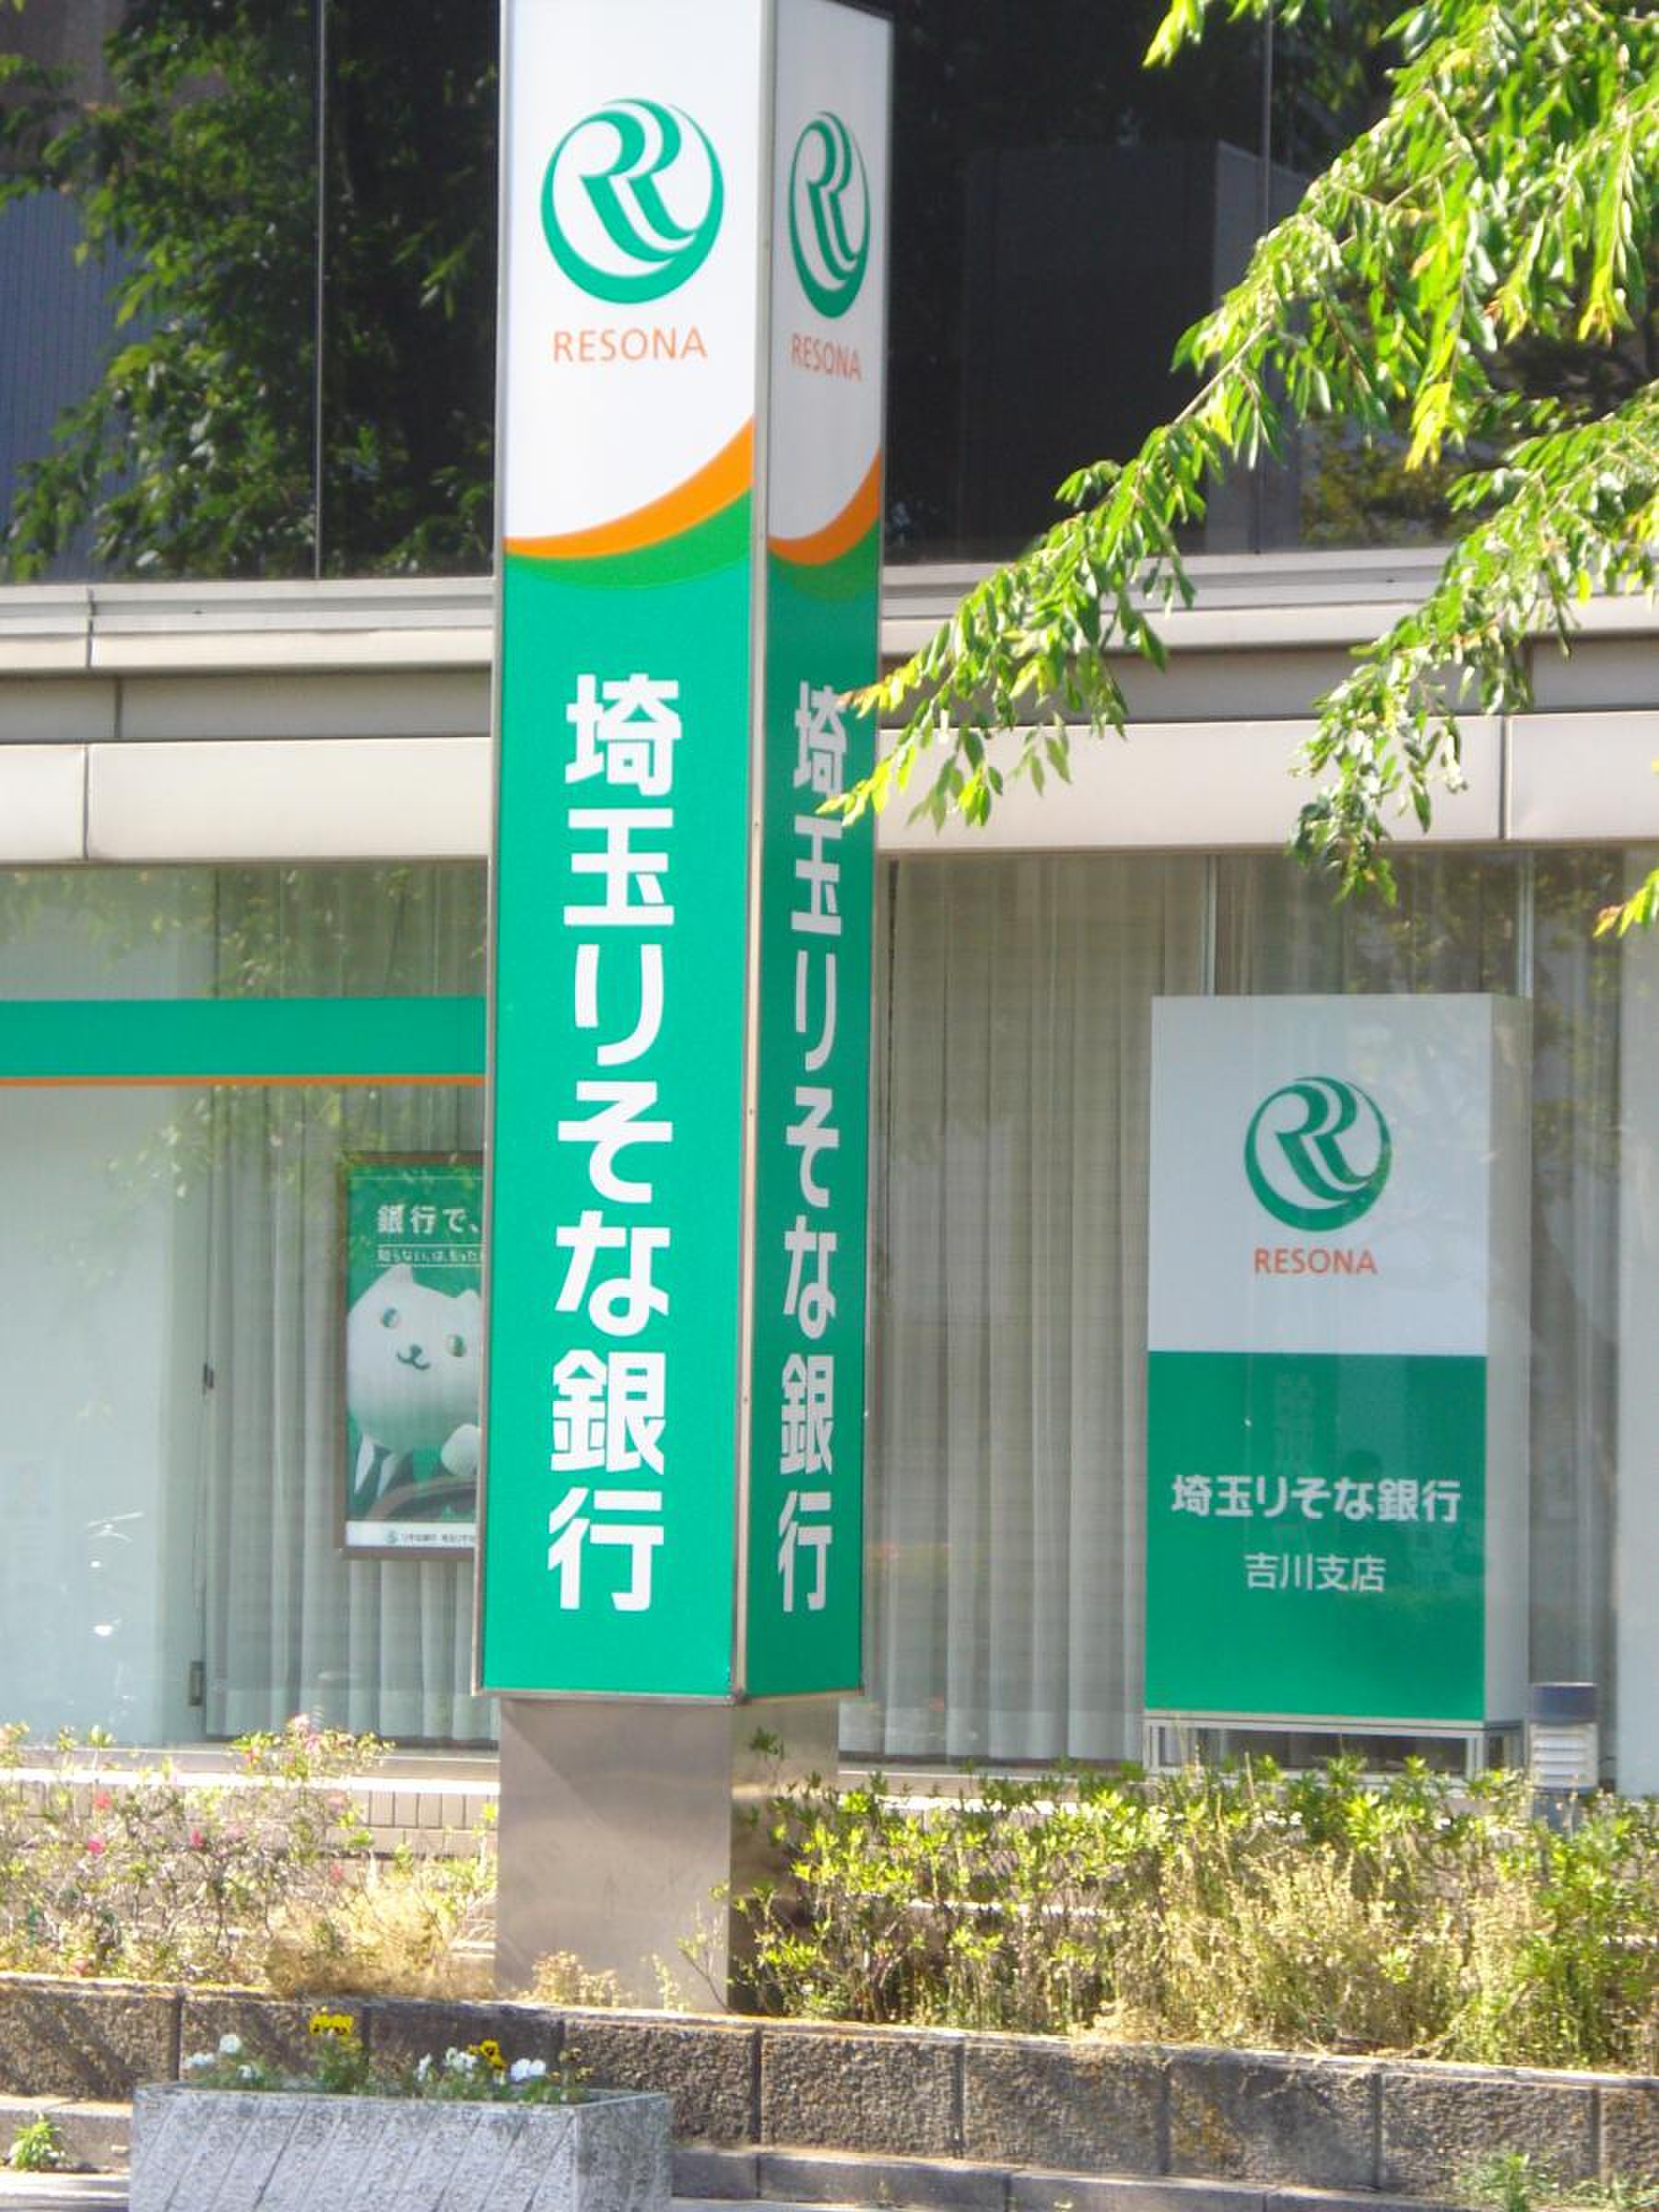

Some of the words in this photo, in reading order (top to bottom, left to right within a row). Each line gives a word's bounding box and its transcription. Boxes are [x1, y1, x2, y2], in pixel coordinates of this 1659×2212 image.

[553, 325, 708, 362] RESONA
[791, 333, 862, 380] RESONA
[547, 673, 682, 1611] 埼玉りそな銀行
[778, 680, 847, 1612] 埼玉りそな銀行
[1254, 1248, 1377, 1275] RESONA
[1171, 1474, 1462, 1523] 埼玉りそな銀行
[1244, 1552, 1387, 1593] 吉川支店
